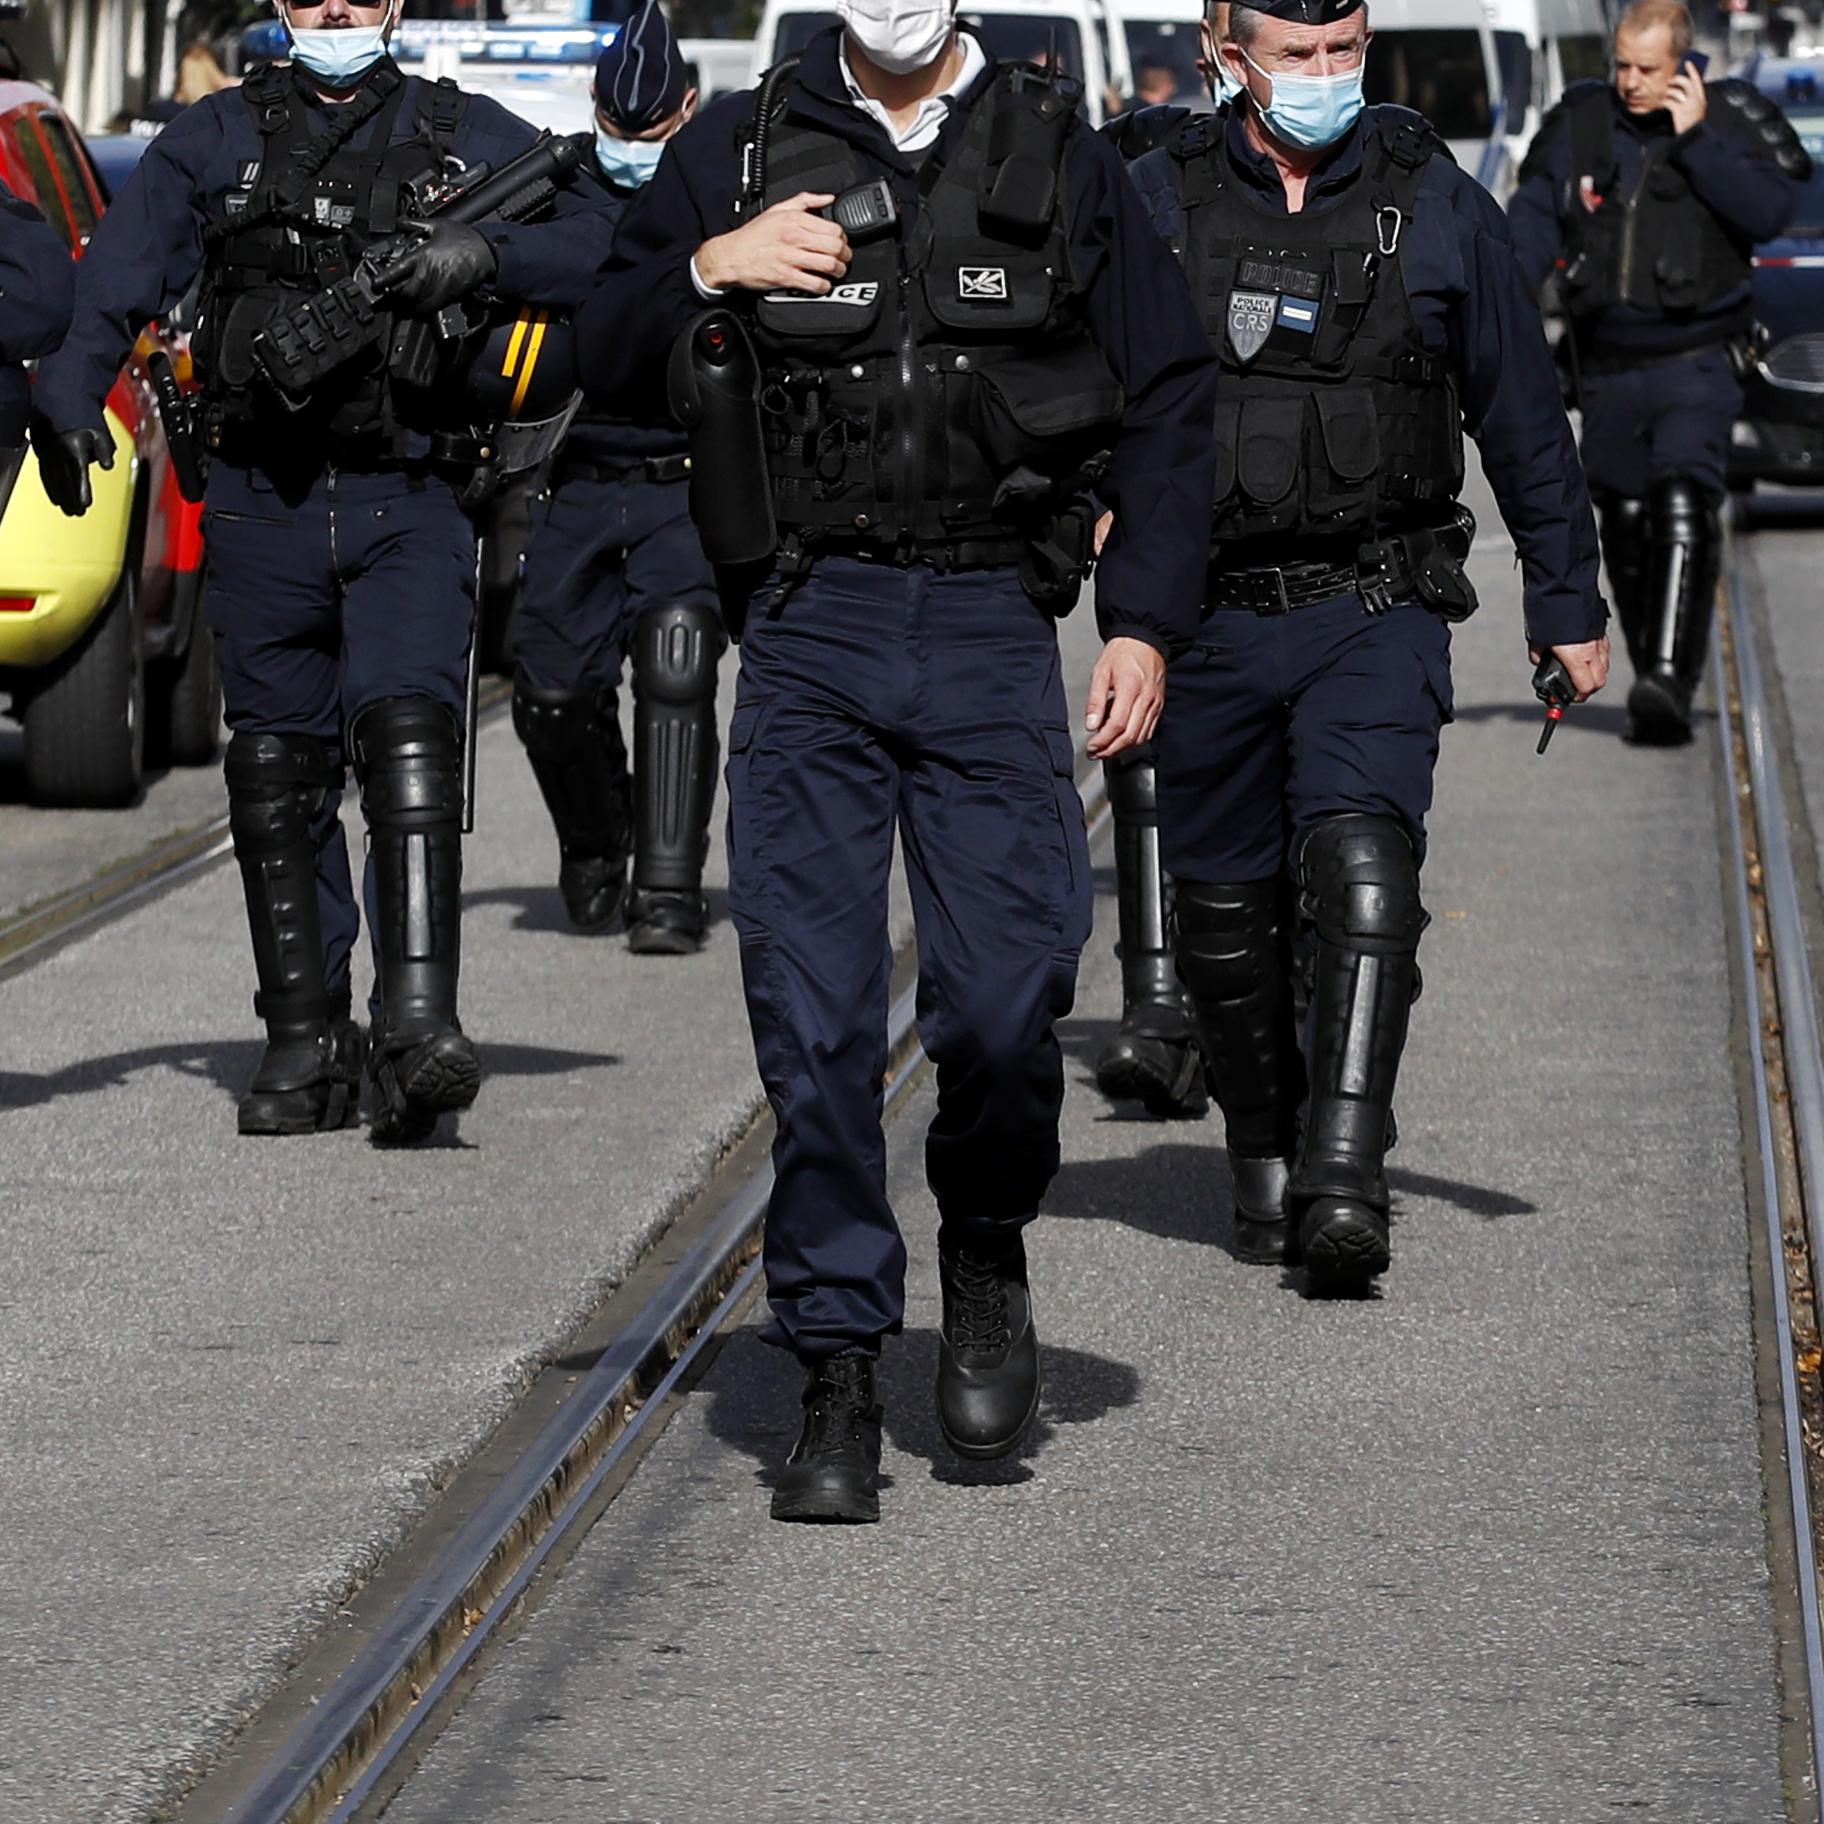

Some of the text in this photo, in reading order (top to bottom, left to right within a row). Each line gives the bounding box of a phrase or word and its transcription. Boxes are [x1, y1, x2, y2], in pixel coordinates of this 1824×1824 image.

[1242, 261, 1318, 294] POLICE
[1236, 296, 1271, 307] POLICE
[1232, 312, 1269, 332] CRS
